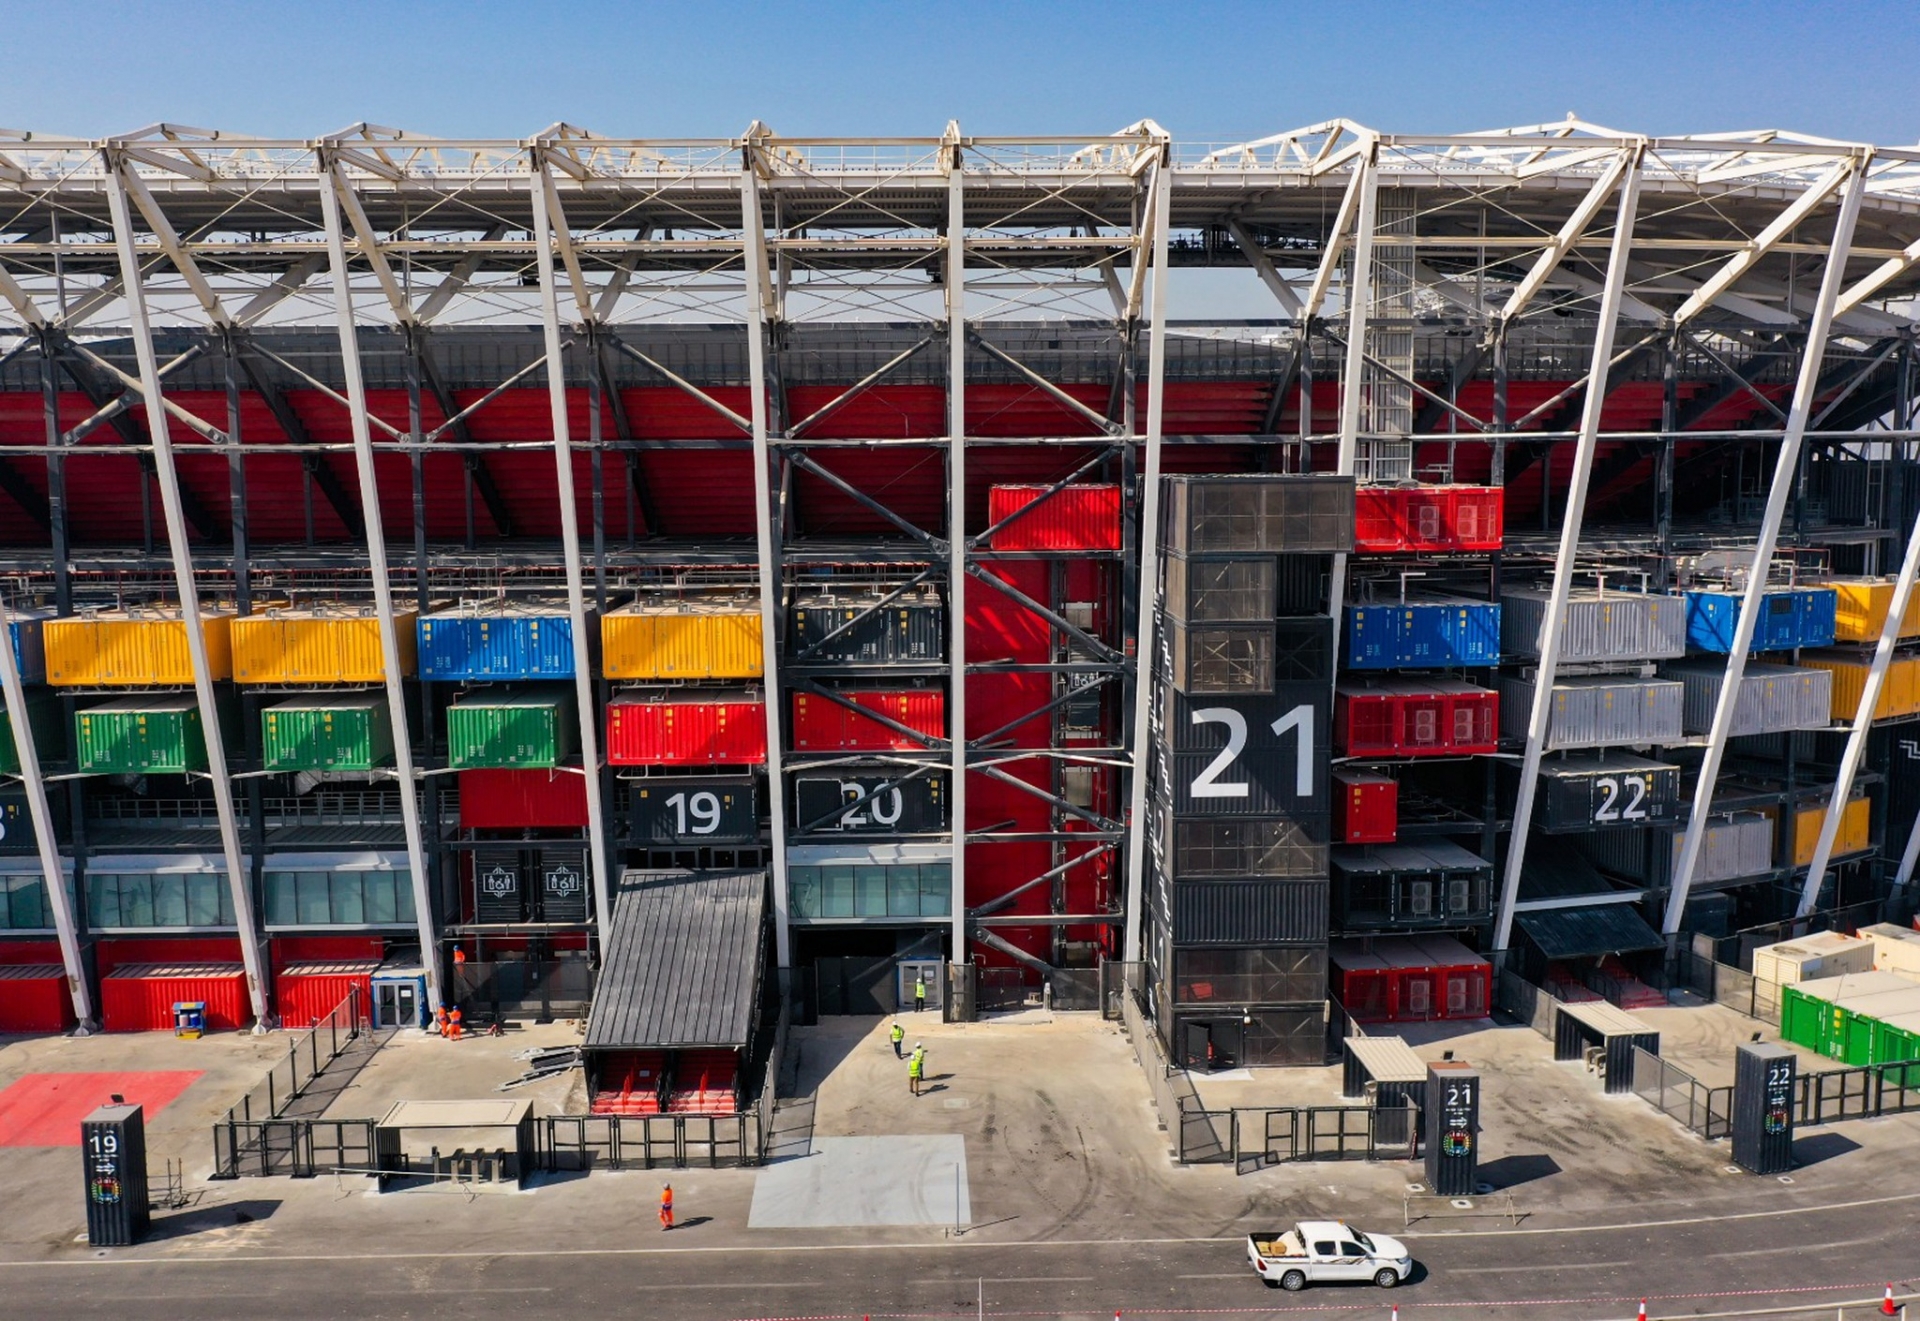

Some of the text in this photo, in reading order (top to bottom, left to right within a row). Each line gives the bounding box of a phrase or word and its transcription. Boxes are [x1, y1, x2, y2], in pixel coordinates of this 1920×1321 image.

[1190, 705, 1314, 798] 21
[665, 791, 721, 834] 19
[841, 782, 902, 825] 20
[1595, 776, 1646, 821] 22
[1447, 1088, 1471, 1106] 21
[1768, 1067, 1790, 1086] 22
[90, 1135, 117, 1153] 19
